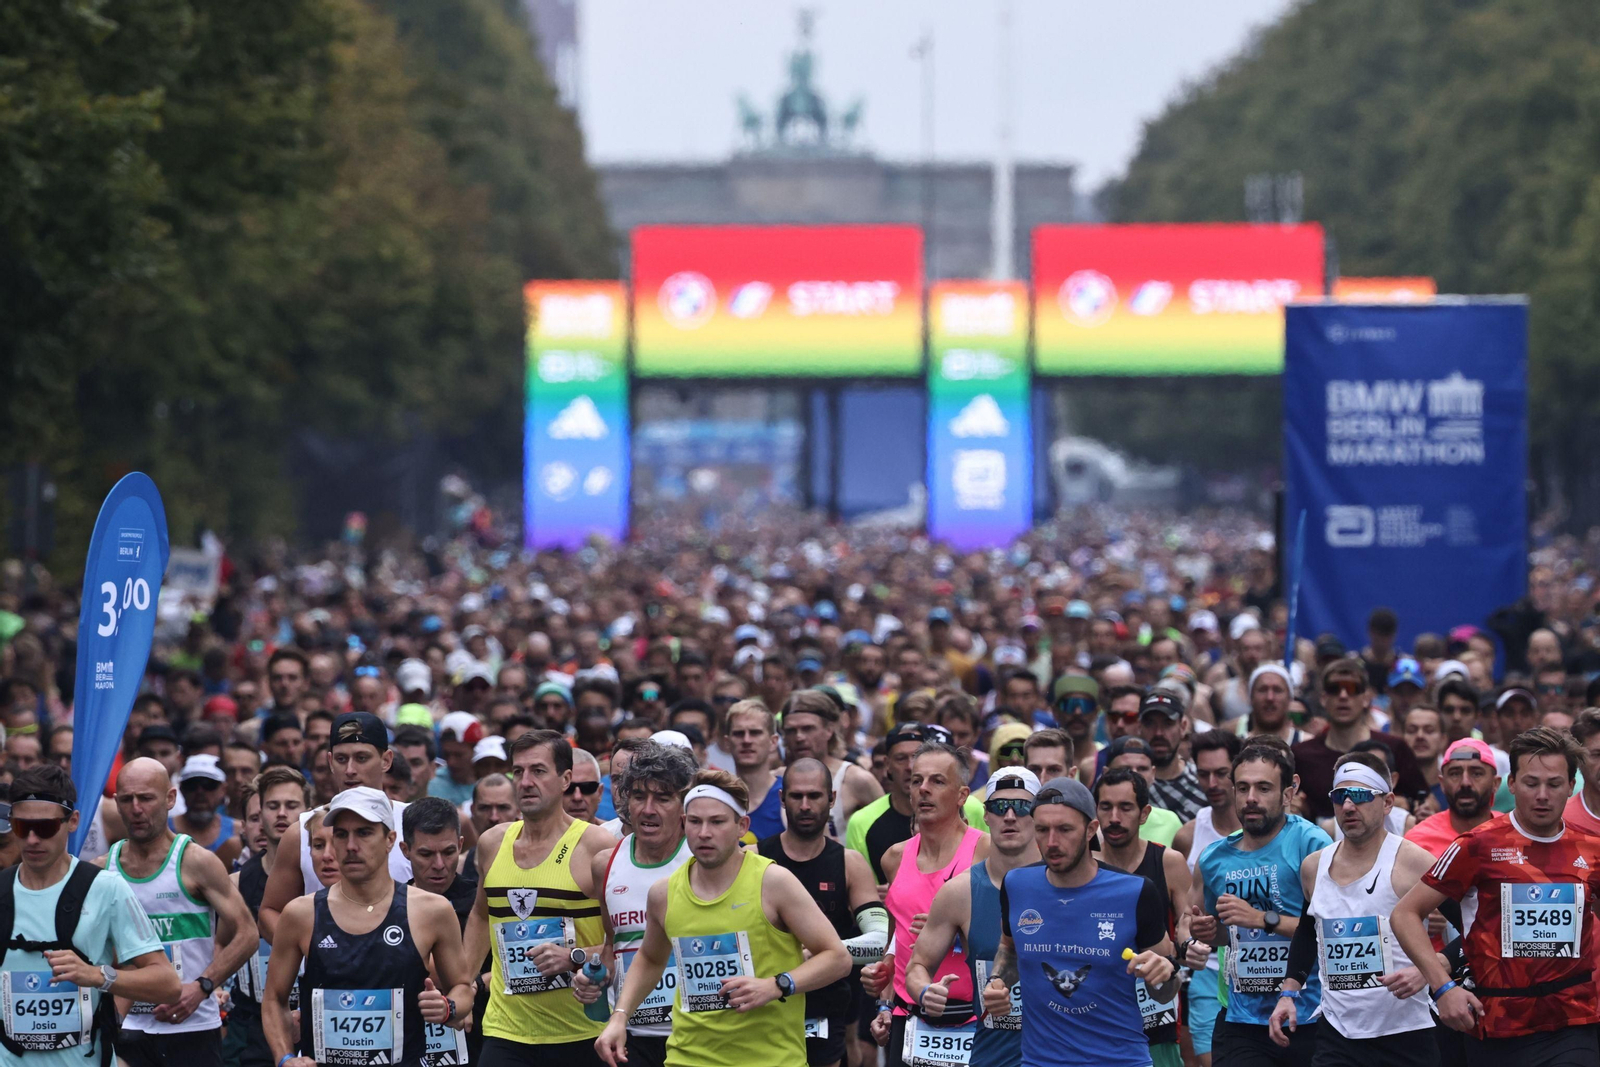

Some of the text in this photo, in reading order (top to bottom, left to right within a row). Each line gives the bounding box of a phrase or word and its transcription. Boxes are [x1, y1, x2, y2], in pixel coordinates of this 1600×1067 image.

[1326, 379, 1425, 415] BMW
[1326, 417, 1427, 441] BERLIN
[1327, 441, 1486, 466] MARATHON
[119, 547, 134, 556] BERLIN
[555, 844, 569, 865] soar
[1225, 865, 1269, 882] ABSOLUTE
[1514, 909, 1572, 926] 35489
[1532, 930, 1557, 939] Stian
[1024, 943, 1052, 953] MANU
[1326, 942, 1376, 960] 29724
[1514, 942, 1556, 950] IMPOSSIBLE
[1239, 946, 1290, 963] 24282
[684, 959, 738, 980] 30285
[1246, 966, 1283, 975] Matthias
[1334, 961, 1369, 971] Tor Erik
[518, 984, 546, 993] NOTHING
[697, 981, 723, 992] Philip
[1246, 985, 1273, 993] NOTHING
[1333, 981, 1362, 989] NOTHING
[82, 993, 90, 1001] B
[15, 998, 76, 1017] 64997
[633, 1007, 663, 1017] POSSIBLE
[695, 1003, 724, 1011] NOTHING
[1048, 1000, 1097, 1014] PIERCING
[1141, 1003, 1157, 1014] cott
[395, 1011, 402, 1019] C
[635, 1015, 663, 1024] NOTHING
[31, 1020, 57, 1031] Josia
[330, 1016, 386, 1033] 14767
[15, 1034, 57, 1042] IMPOSSIBLE
[342, 1037, 374, 1046] Dustin
[919, 1035, 973, 1051] 35816
[326, 1049, 369, 1058] IMPOSSIBLE
[927, 1050, 965, 1061] Christof
[333, 1057, 367, 1066] NOTHING
